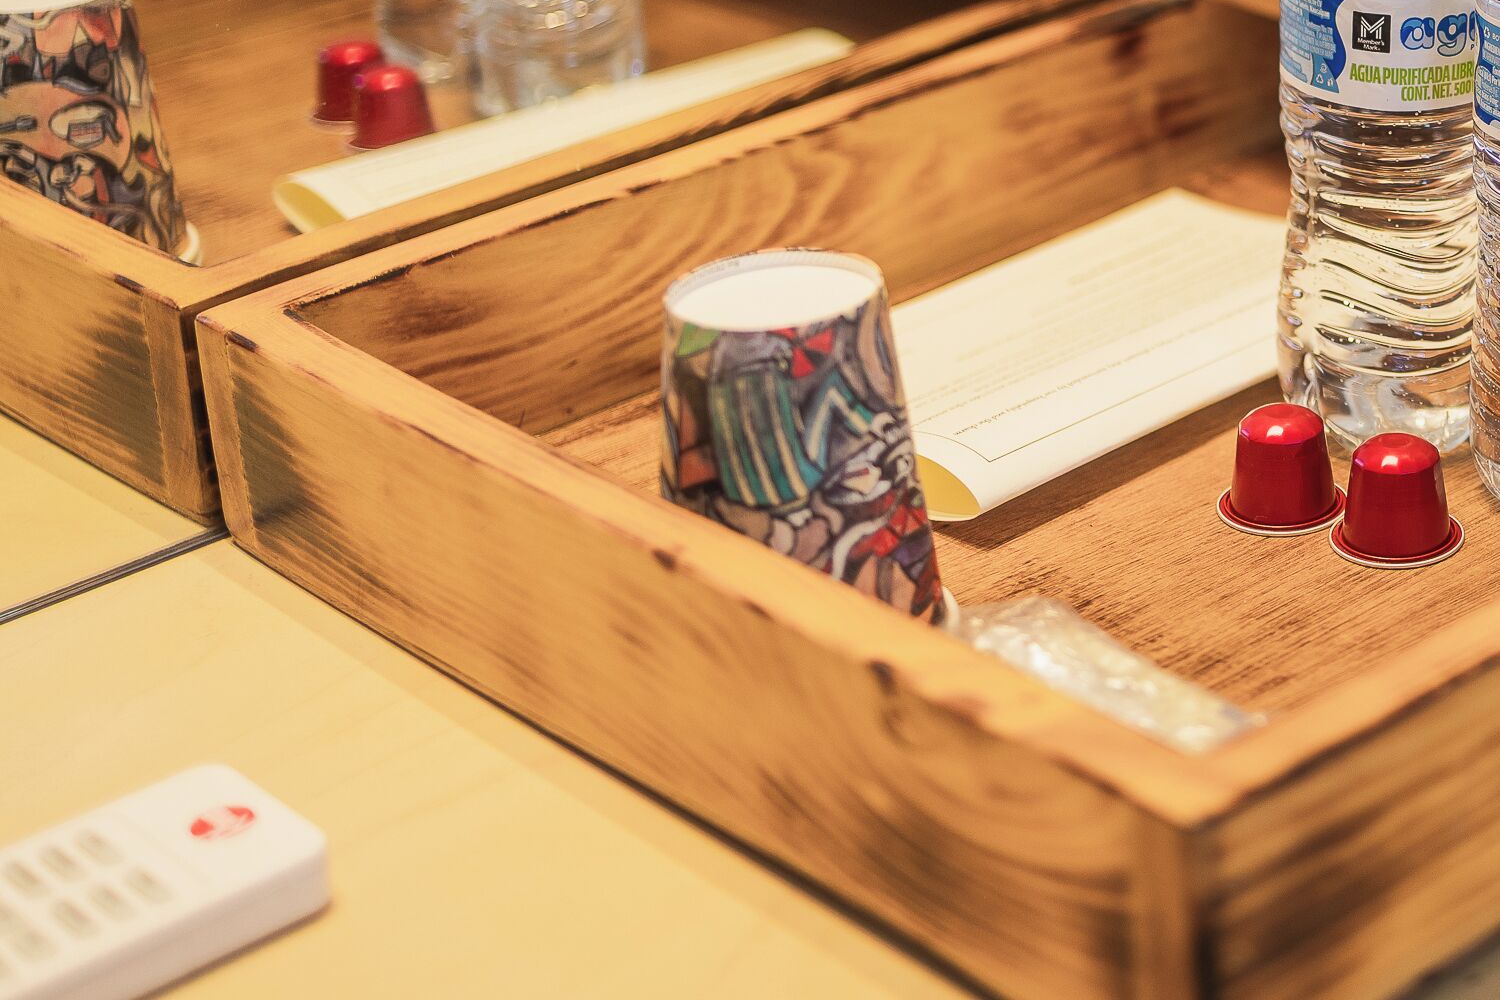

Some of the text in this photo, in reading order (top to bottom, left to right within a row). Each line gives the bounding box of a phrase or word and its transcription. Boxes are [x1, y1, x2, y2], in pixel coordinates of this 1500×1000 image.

[1350, 63, 1381, 84] AGUA
[1382, 64, 1449, 85] PURIFICADA
[1452, 60, 1474, 79] LIBR
[1401, 85, 1430, 101] CONT.
[1432, 82, 1452, 99] NET.
[1454, 79, 1474, 96] 500
